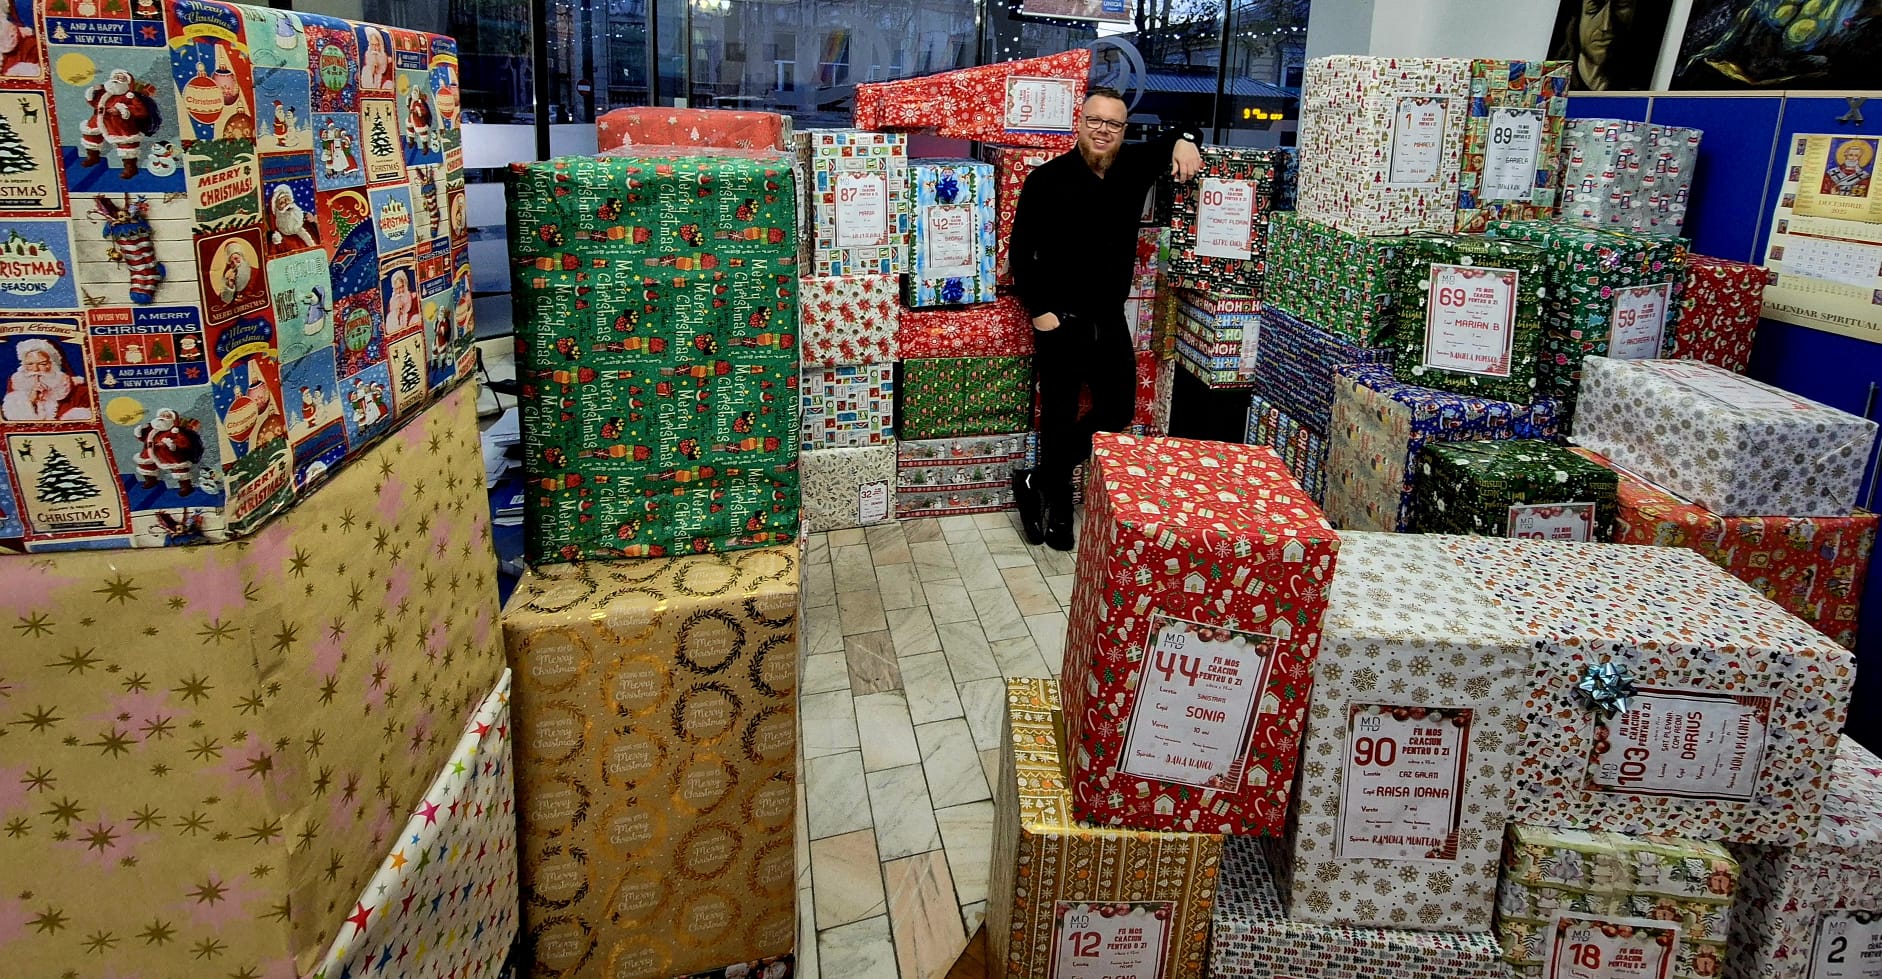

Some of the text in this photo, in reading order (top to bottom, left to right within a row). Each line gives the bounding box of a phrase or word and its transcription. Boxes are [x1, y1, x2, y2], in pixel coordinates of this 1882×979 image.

[190, 0, 224, 16] Merry
[70, 24, 124, 32] AND A HAPPY
[184, 13, 232, 29] Christmas
[75, 35, 122, 44] NEW YEAR!
[186, 96, 221, 104] Christmas
[1020, 106, 1032, 122] 40
[1405, 114, 1412, 129] 1
[1494, 127, 1512, 144] 89
[198, 168, 240, 187] MERRY
[200, 178, 252, 206] CHRISTMAS!
[533, 170, 546, 214] Merry
[677, 171, 696, 214] Merry
[841, 188, 857, 202] 87
[1203, 190, 1222, 206] 80
[517, 182, 540, 252] Christmas
[660, 184, 681, 252] Christmas
[932, 218, 948, 230] 42
[1, 282, 47, 292] SEASONS
[615, 259, 632, 303] Merry
[750, 258, 768, 300] Merry
[554, 283, 572, 327] Merry
[692, 282, 710, 324] Merry
[732, 272, 752, 337] Christmas
[1440, 288, 1466, 307] 69
[150, 312, 192, 320] MERRY
[212, 300, 266, 320] MERRY CHRISTMAS
[596, 273, 618, 342] Christmas
[1763, 301, 1880, 330] CALENDAR SPIRITUAL
[1455, 320, 1500, 331] MARIAN B
[1618, 309, 1636, 328] 59
[94, 324, 196, 335] CHRISTMAS
[228, 324, 258, 338] Merry
[536, 296, 558, 366] Christmas
[675, 295, 696, 362] Christmas
[226, 335, 264, 352] Christmas
[119, 369, 134, 377] AND
[144, 368, 169, 376] HAPPY
[124, 378, 168, 388] NEW YEAR!
[600, 370, 618, 411] Merry
[734, 364, 750, 405] Merry
[540, 395, 558, 438] Merry
[582, 384, 604, 448] Christmas
[716, 377, 736, 442] Christmas
[227, 415, 256, 428] Christmas
[524, 406, 544, 474] Christmas
[237, 467, 276, 500] MERRY
[236, 470, 286, 518] CHRISTMAS!
[861, 490, 872, 498] 32
[38, 508, 110, 522] CHRISTMAS
[696, 636, 726, 651] Merry
[689, 648, 730, 660] Christmas
[1224, 657, 1240, 668] MOS
[1156, 650, 1201, 686] 44
[1208, 664, 1238, 676] CRACIUN
[622, 679, 655, 692] Merry
[1200, 671, 1227, 684] PENTRU
[1234, 678, 1243, 686] ZI
[694, 708, 724, 722] Merry
[1186, 706, 1226, 724] SONIA
[1643, 703, 1652, 711] ZI
[1413, 728, 1442, 736] FII MOS
[1629, 710, 1640, 740] CRACIUN
[1639, 720, 1650, 747] PENTRU
[1681, 711, 1703, 760] DARIUS
[1354, 737, 1397, 767] 90
[1402, 746, 1432, 755] PENTRU
[1617, 748, 1649, 786] 103
[1377, 786, 1409, 797] RAISA
[1414, 787, 1449, 798] IOANA
[1068, 931, 1102, 957] 12
[1827, 936, 1847, 963] 2
[1569, 944, 1601, 969] 18
